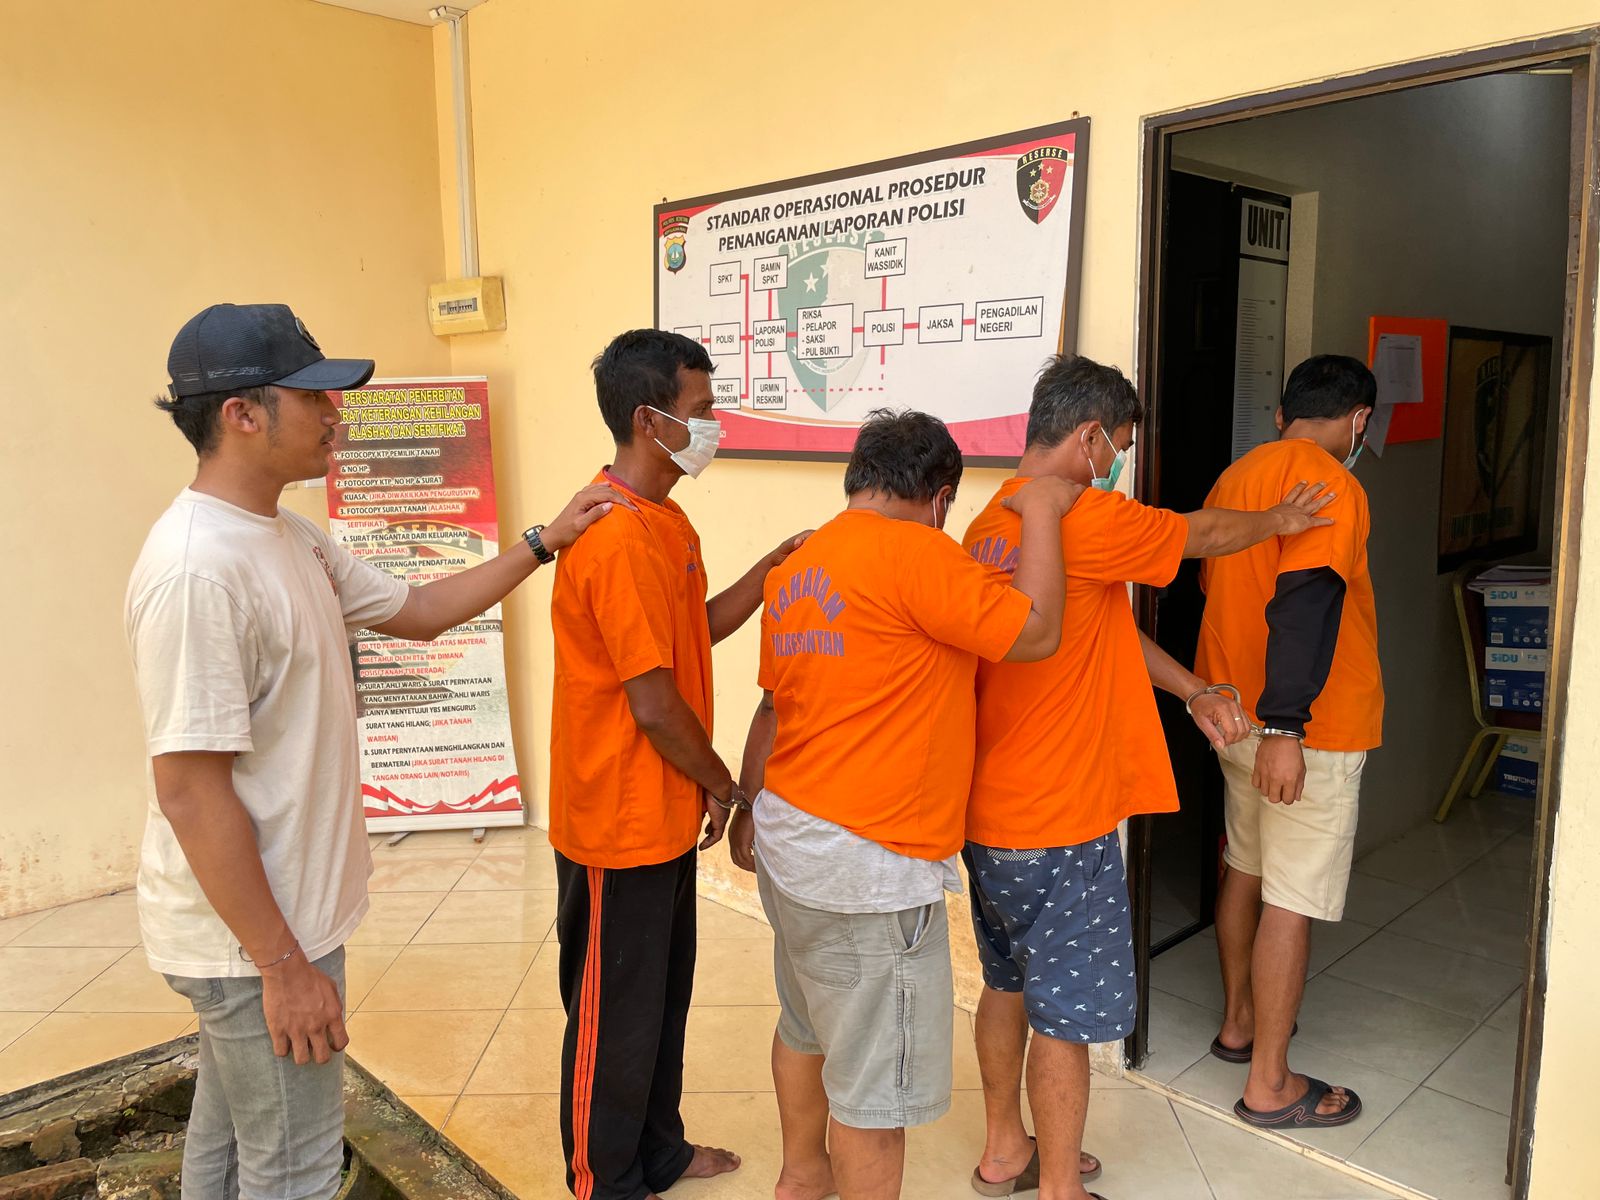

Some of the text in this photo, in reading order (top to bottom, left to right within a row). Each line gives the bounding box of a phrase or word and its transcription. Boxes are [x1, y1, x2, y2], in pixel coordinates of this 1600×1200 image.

[1022, 148, 1063, 164] RESERSE
[706, 166, 986, 231] STANDAR OPERASIONAL PROSEDUR
[718, 221, 821, 252] PENANGANAN
[824, 208, 903, 236] LAPORAN
[908, 198, 966, 224] POLISI
[1247, 205, 1284, 250] UNIT
[874, 246, 898, 258] KANIT
[760, 262, 781, 273] BAMIN
[867, 259, 904, 272] WASSIDIK
[717, 274, 734, 284] SPKT
[762, 274, 779, 285] SPKT
[802, 310, 822, 320] RIKSA
[980, 305, 1038, 318] PENGADILAN
[806, 321, 836, 332] PELAPOR
[872, 322, 896, 333] POLISI
[927, 318, 954, 330] JAKSA
[980, 321, 1013, 333] NEGERI
[755, 324, 784, 336] LAPORAN
[716, 335, 734, 344] POLISI
[755, 338, 776, 348] POLISI
[806, 334, 826, 344] SAKSI
[806, 348, 818, 356] PUL
[820, 346, 840, 356] BUKTI
[717, 384, 734, 392] PIKET
[760, 384, 780, 392] URMIN
[344, 388, 464, 405] PERSYARATAN PENERBITAN
[756, 394, 784, 404] RESKRIM
[361, 407, 422, 422] KETERANGAN
[424, 405, 480, 419] KEHILANGAN
[349, 424, 392, 440] ALASHAK
[393, 424, 412, 438] DAN
[341, 451, 376, 459] FOTOCOPY
[372, 533, 410, 541] PENGANTAR
[428, 531, 468, 540] KELURAHAN
[374, 558, 466, 568] KETERANGAN PENDAFTARAN
[438, 652, 464, 660] DIMANA
[380, 669, 404, 677] TANAH
[364, 682, 385, 690] SURAT
[428, 679, 449, 687] SURAT
[450, 677, 492, 686] PERNYATAAN
[384, 694, 428, 702] MENYATAKAN
[428, 692, 453, 700] BAHWA
[470, 690, 490, 698] WARIS
[390, 707, 430, 715] MENYETUJUI
[449, 718, 472, 726] TANAH
[367, 735, 398, 744] WARISAN)
[370, 748, 391, 756] SURAT
[392, 746, 434, 754] PERNYATAAN
[434, 744, 490, 752] MENGHILANGKAN
[371, 760, 410, 769] BERMATERAI
[428, 758, 449, 766] SURAT
[450, 756, 472, 764] TANAH
[473, 755, 497, 763] HILANG
[372, 774, 400, 782] TANGAN
[400, 772, 423, 780] ORANG
